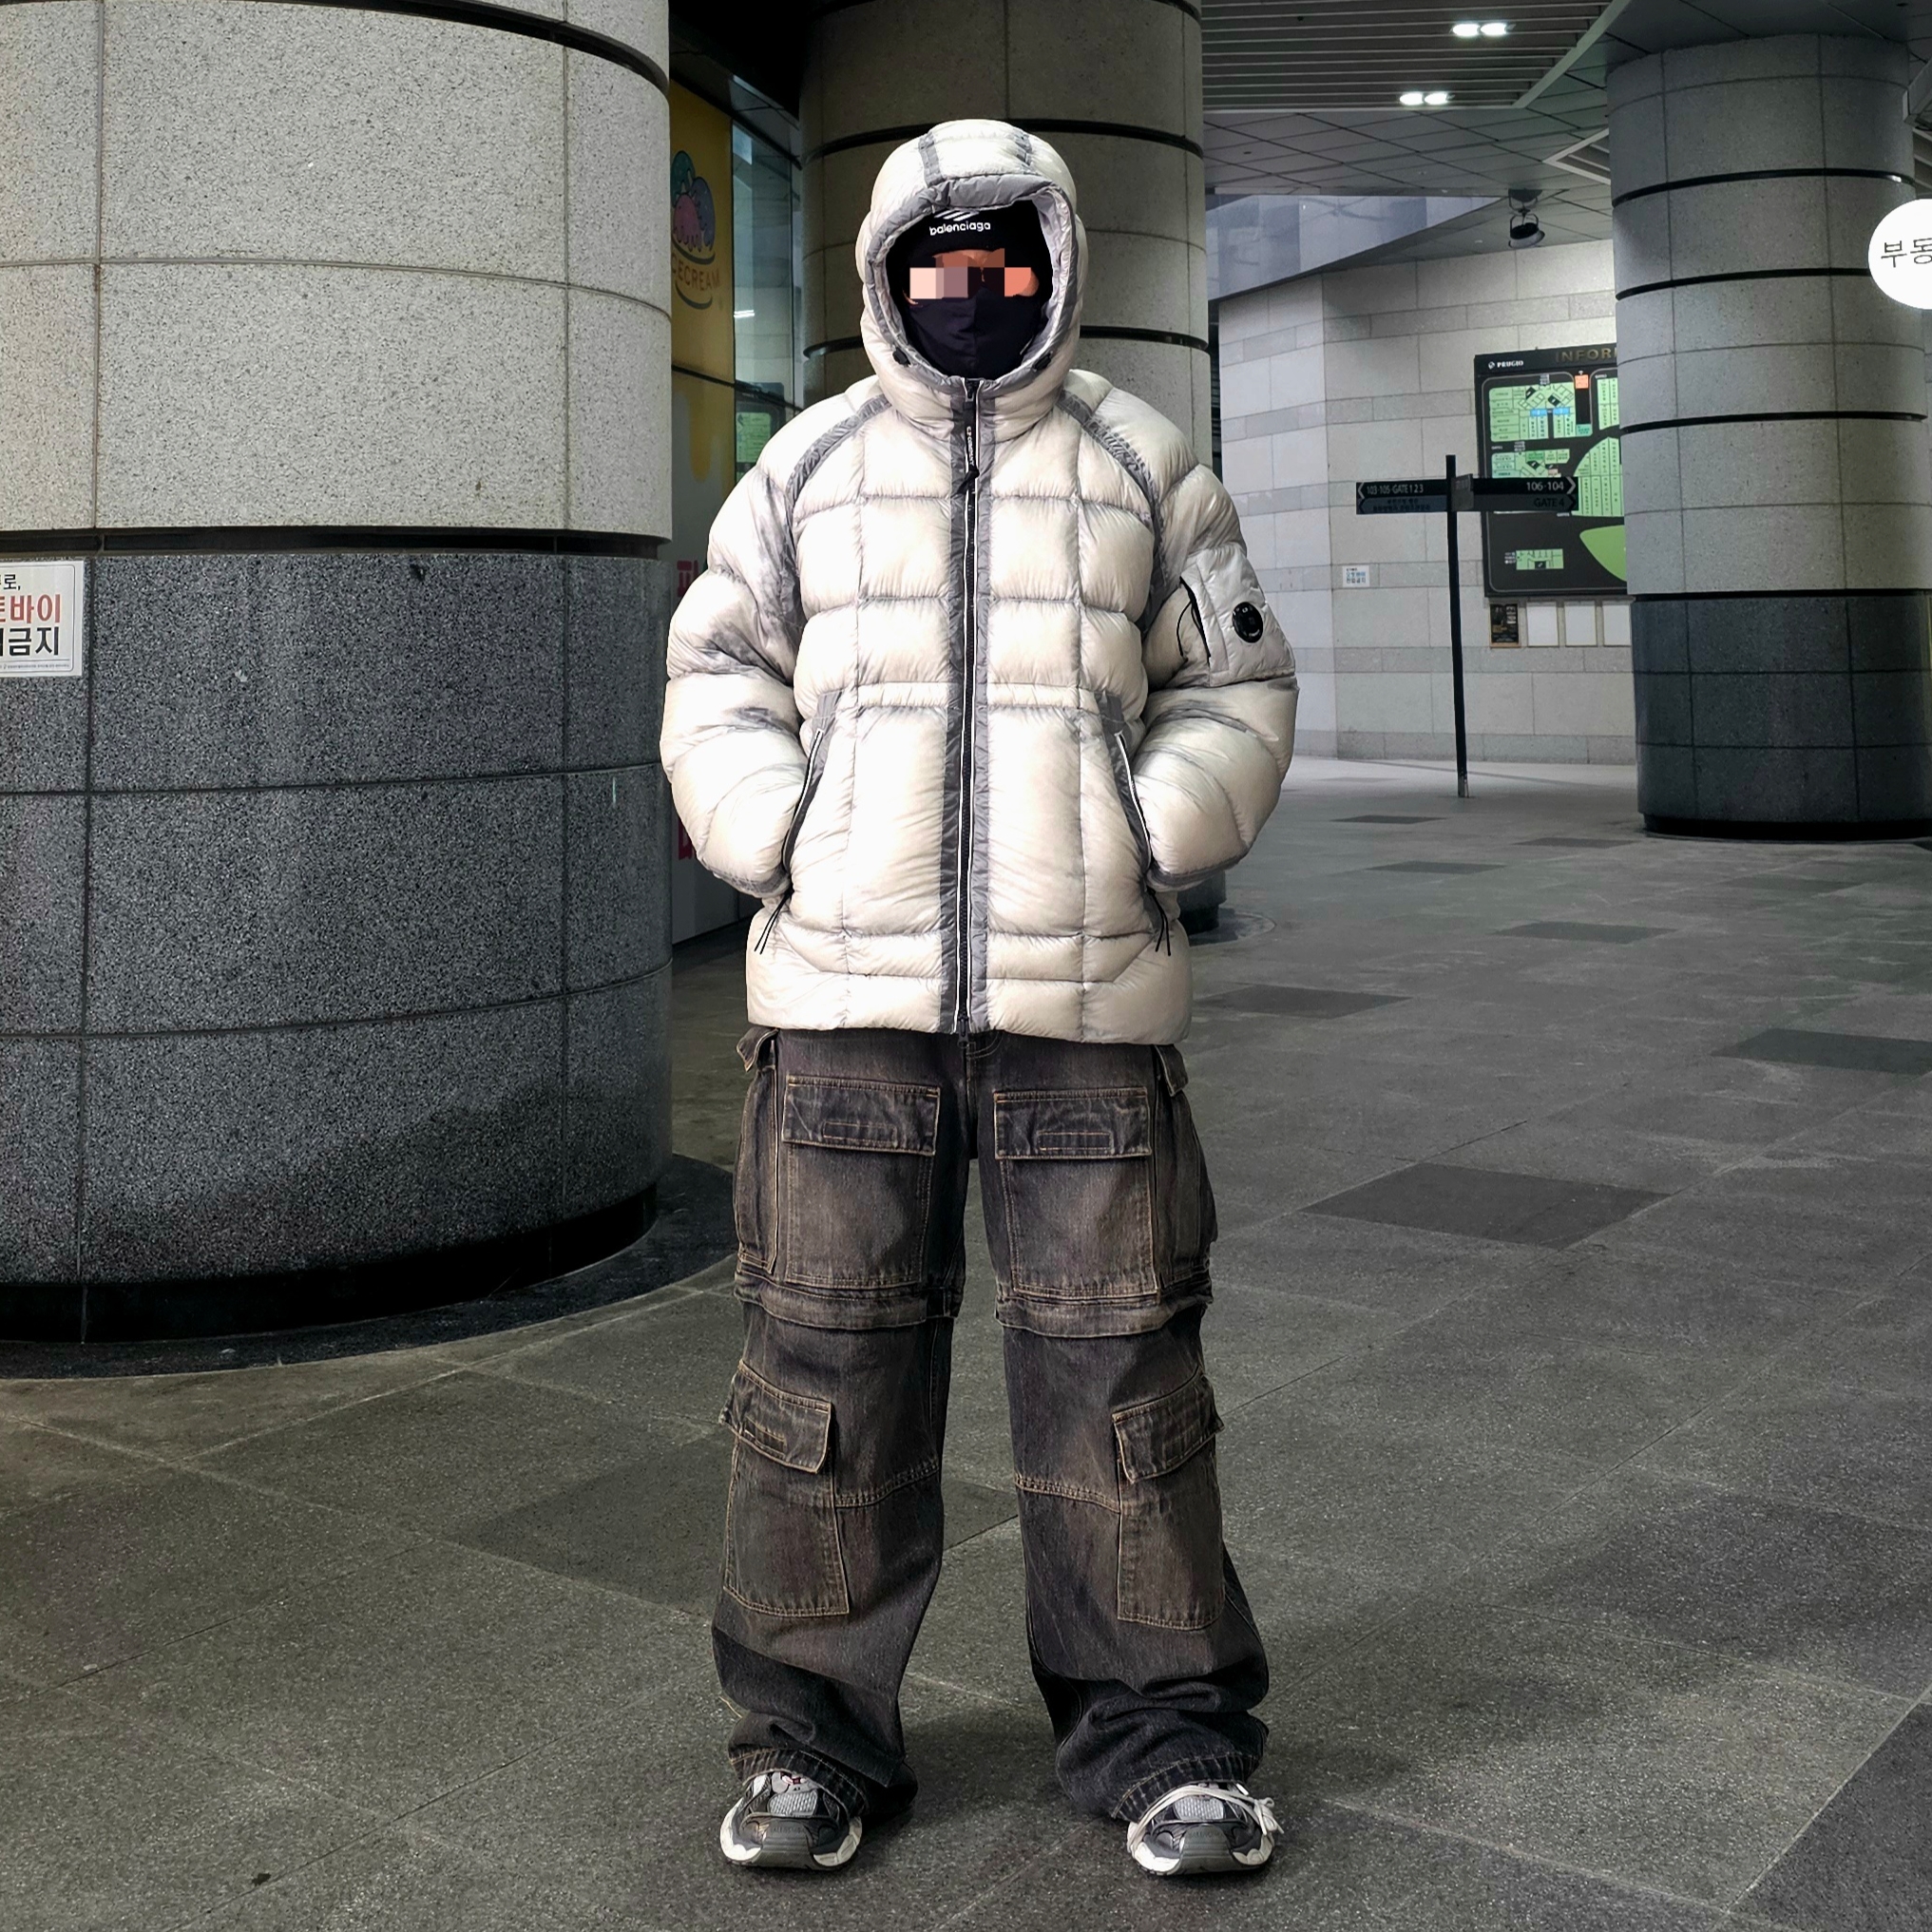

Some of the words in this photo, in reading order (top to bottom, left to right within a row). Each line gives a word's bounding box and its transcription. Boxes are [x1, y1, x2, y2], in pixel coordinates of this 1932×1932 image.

[929, 220, 991, 236] balenciaga
[1881, 238, 1932, 268] 부동
[1556, 347, 1617, 362] INFOR
[1497, 359, 1524, 368] PRUGIO
[1534, 497, 1558, 507] GATE
[1559, 497, 1565, 507] 4
[0, 574, 21, 590] 로,
[0, 594, 60, 624] 바이
[0, 626, 59, 657] 금지
